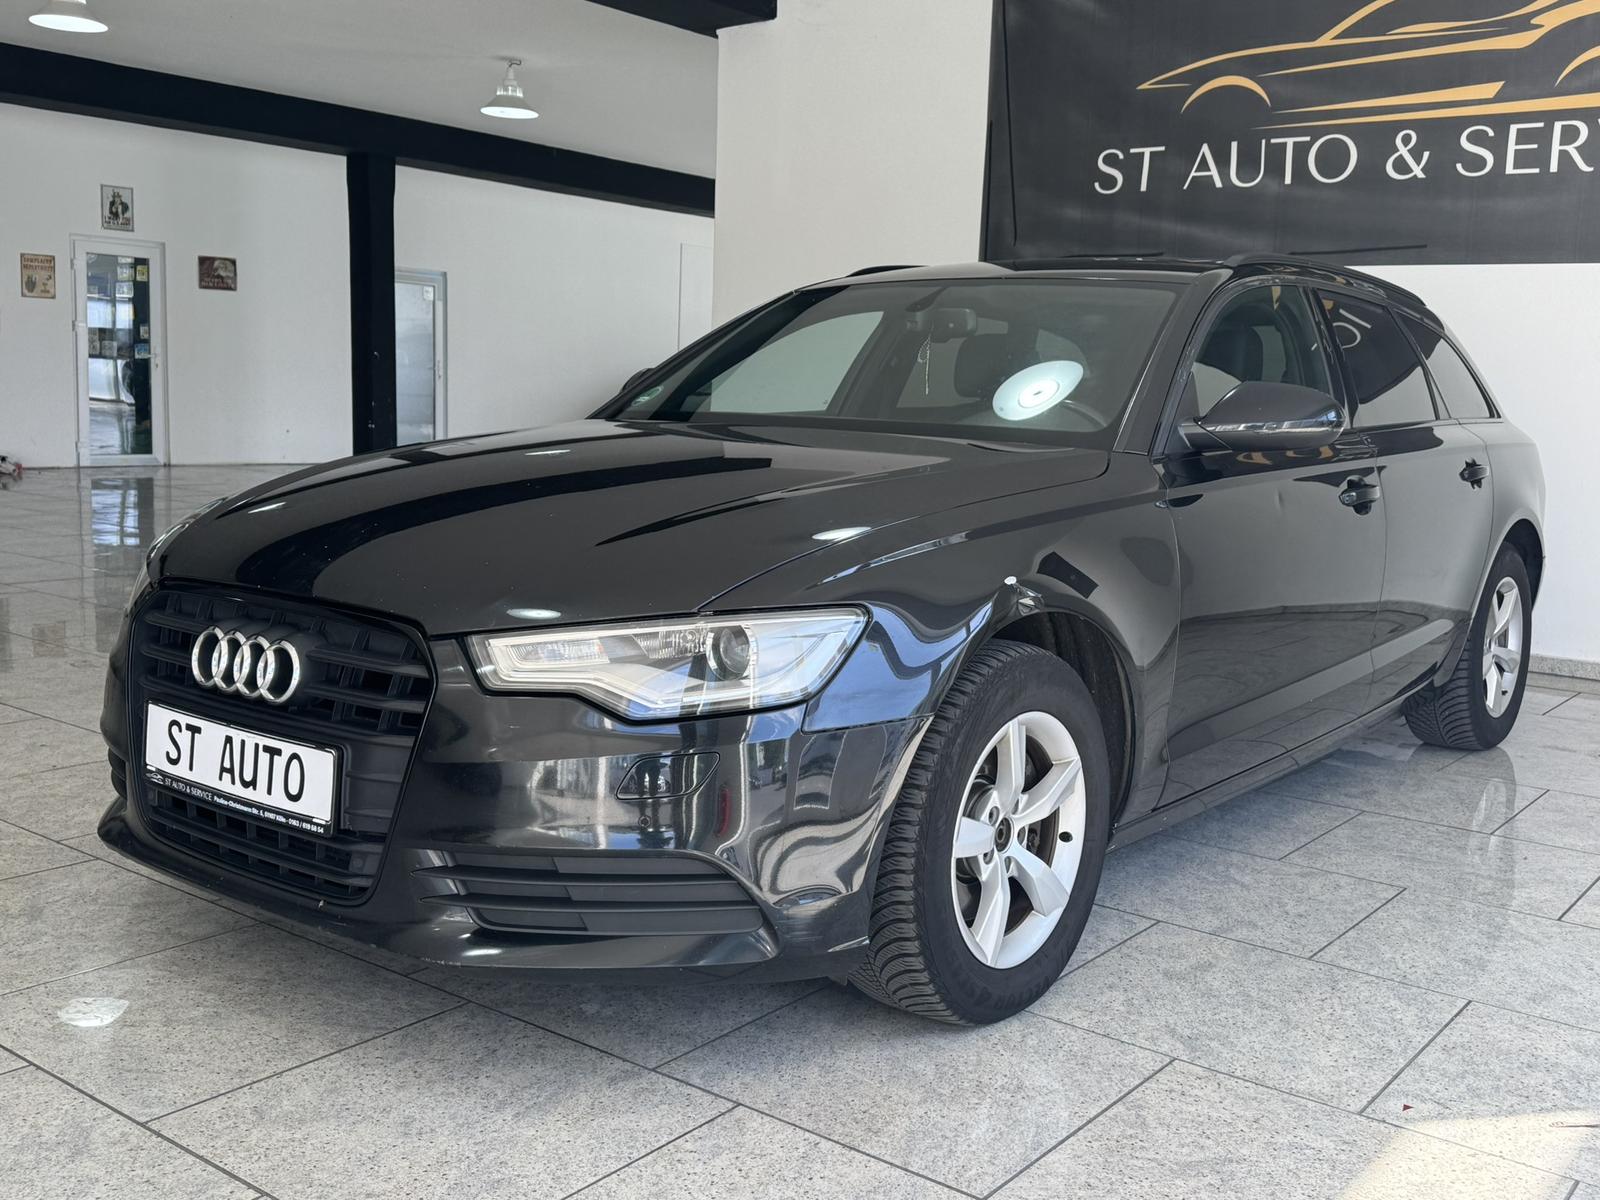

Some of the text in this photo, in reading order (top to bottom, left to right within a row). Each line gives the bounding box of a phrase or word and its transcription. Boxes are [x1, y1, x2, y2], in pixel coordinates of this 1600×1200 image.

[1094, 118, 1600, 194] ST AUTO & SER
[165, 719, 306, 803] ST AUTO
[172, 780, 186, 792] AUTO
[191, 786, 213, 801] SERVICE
